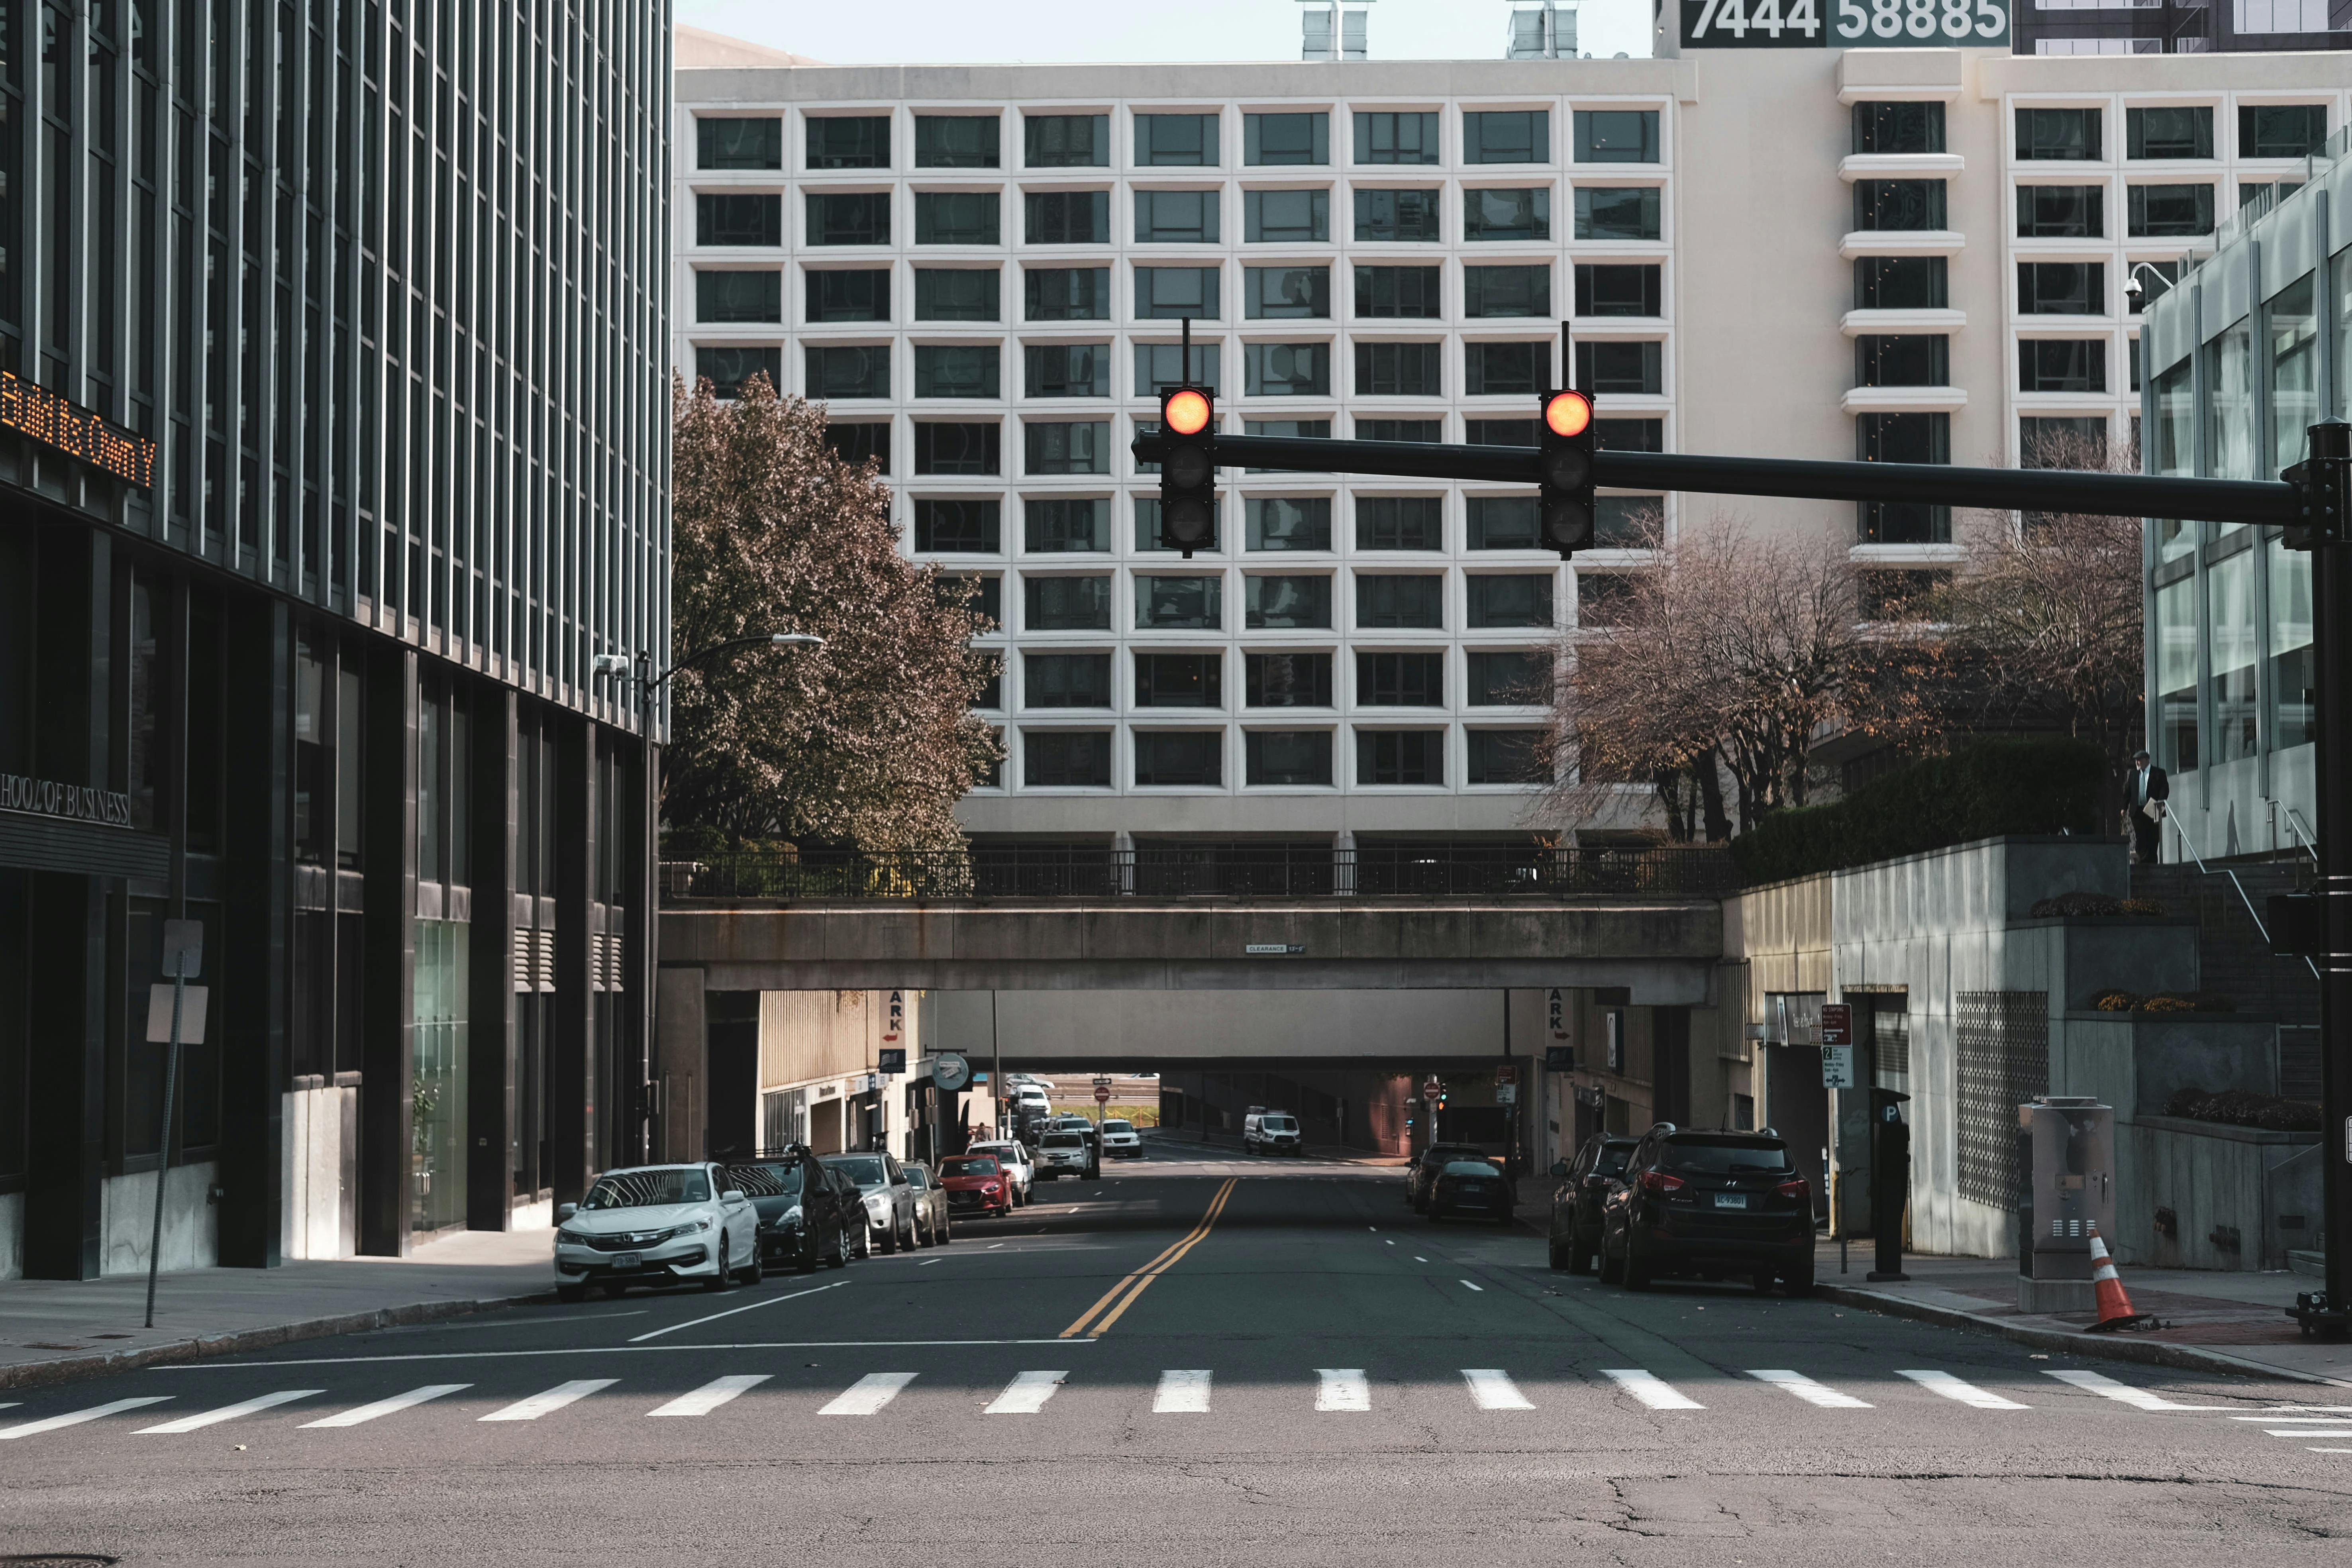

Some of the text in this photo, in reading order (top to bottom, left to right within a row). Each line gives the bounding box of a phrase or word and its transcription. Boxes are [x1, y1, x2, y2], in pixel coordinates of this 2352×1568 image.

[1691, 0, 2006, 38] 7444 58885
[0, 773, 128, 824] HOOL OF BUSINESS
[890, 991, 902, 1030] ARK
[1550, 987, 1562, 1029] ARK
[1825, 1048, 1830, 1059] 2
[1887, 1106, 1897, 1121] P
